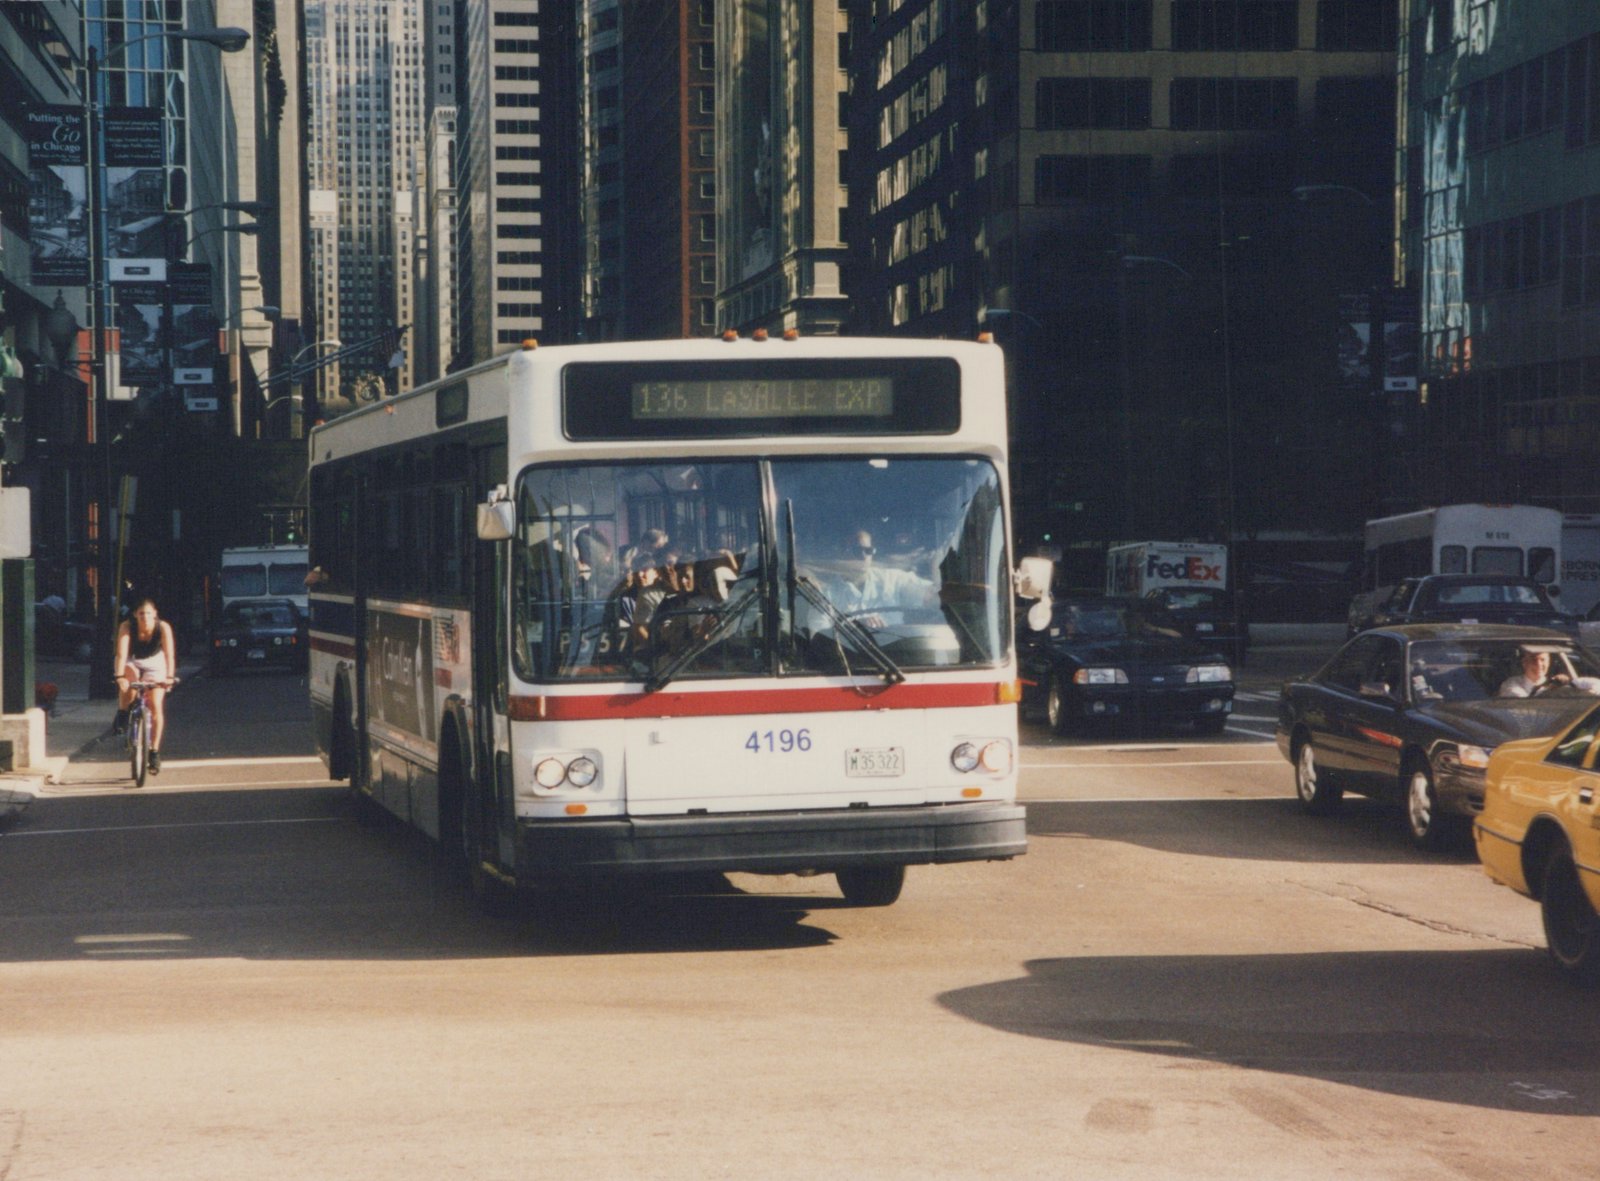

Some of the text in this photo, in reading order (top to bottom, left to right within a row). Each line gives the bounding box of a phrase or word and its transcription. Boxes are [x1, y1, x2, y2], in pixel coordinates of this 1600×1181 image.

[28, 112, 80, 123] Putting the
[52, 122, 80, 143] Go
[31, 141, 80, 153] in Chicago
[640, 384, 687, 412] 136
[835, 380, 881, 410] EXP
[1146, 553, 1222, 581] FedEx
[745, 728, 812, 753] 4196
